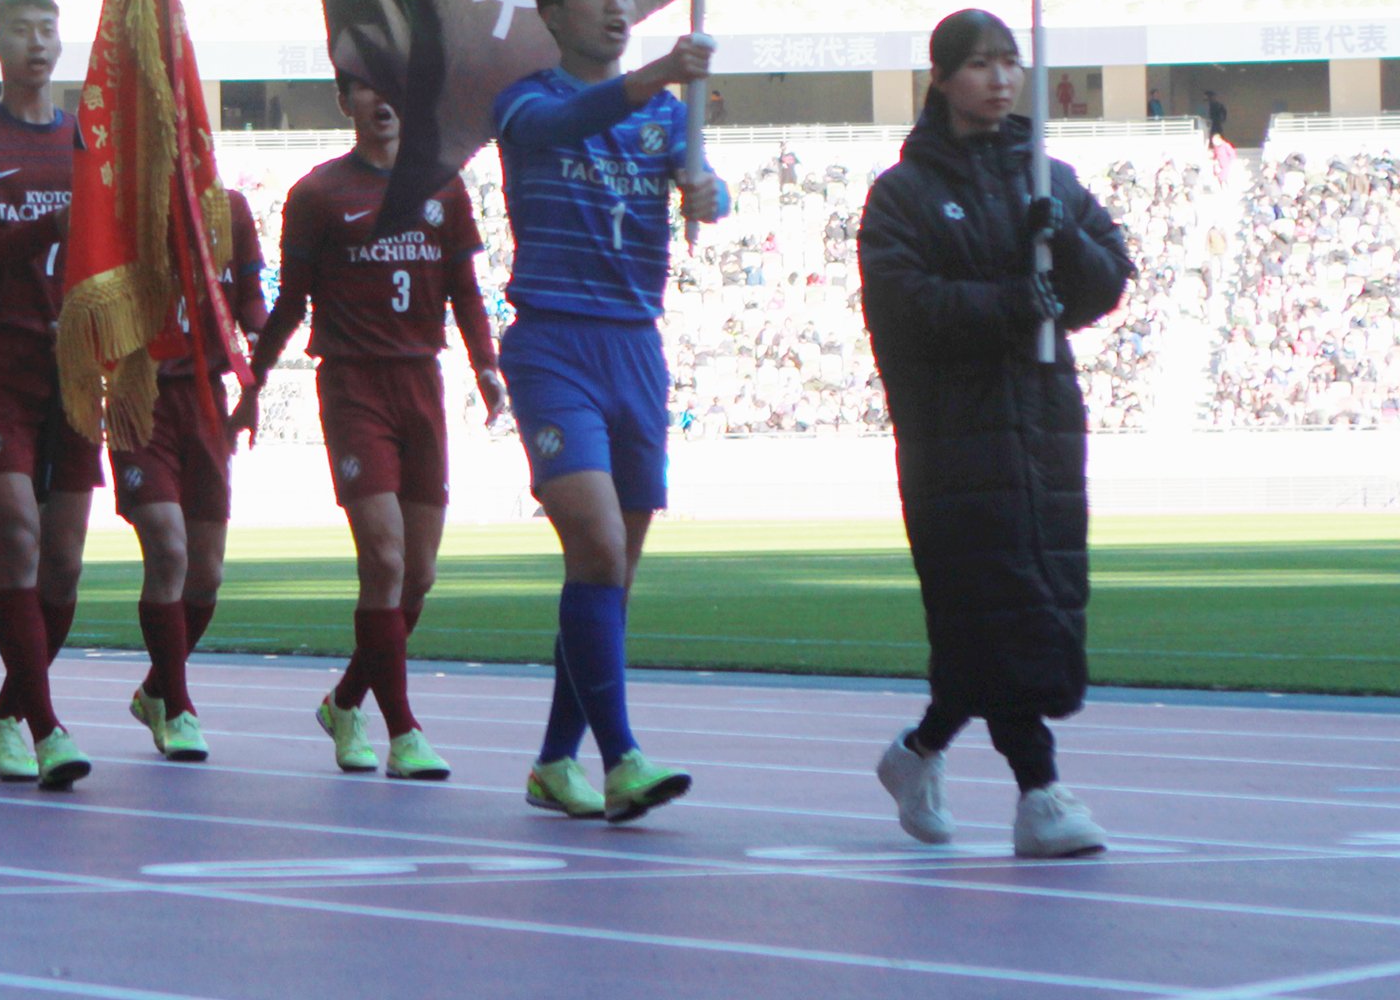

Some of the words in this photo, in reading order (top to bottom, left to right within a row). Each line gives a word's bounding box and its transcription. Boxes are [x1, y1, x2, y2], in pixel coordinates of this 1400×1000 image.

[752, 35, 878, 69] 茨城代表
[1260, 24, 1388, 56] 群馬代表
[392, 270, 411, 312] 3
